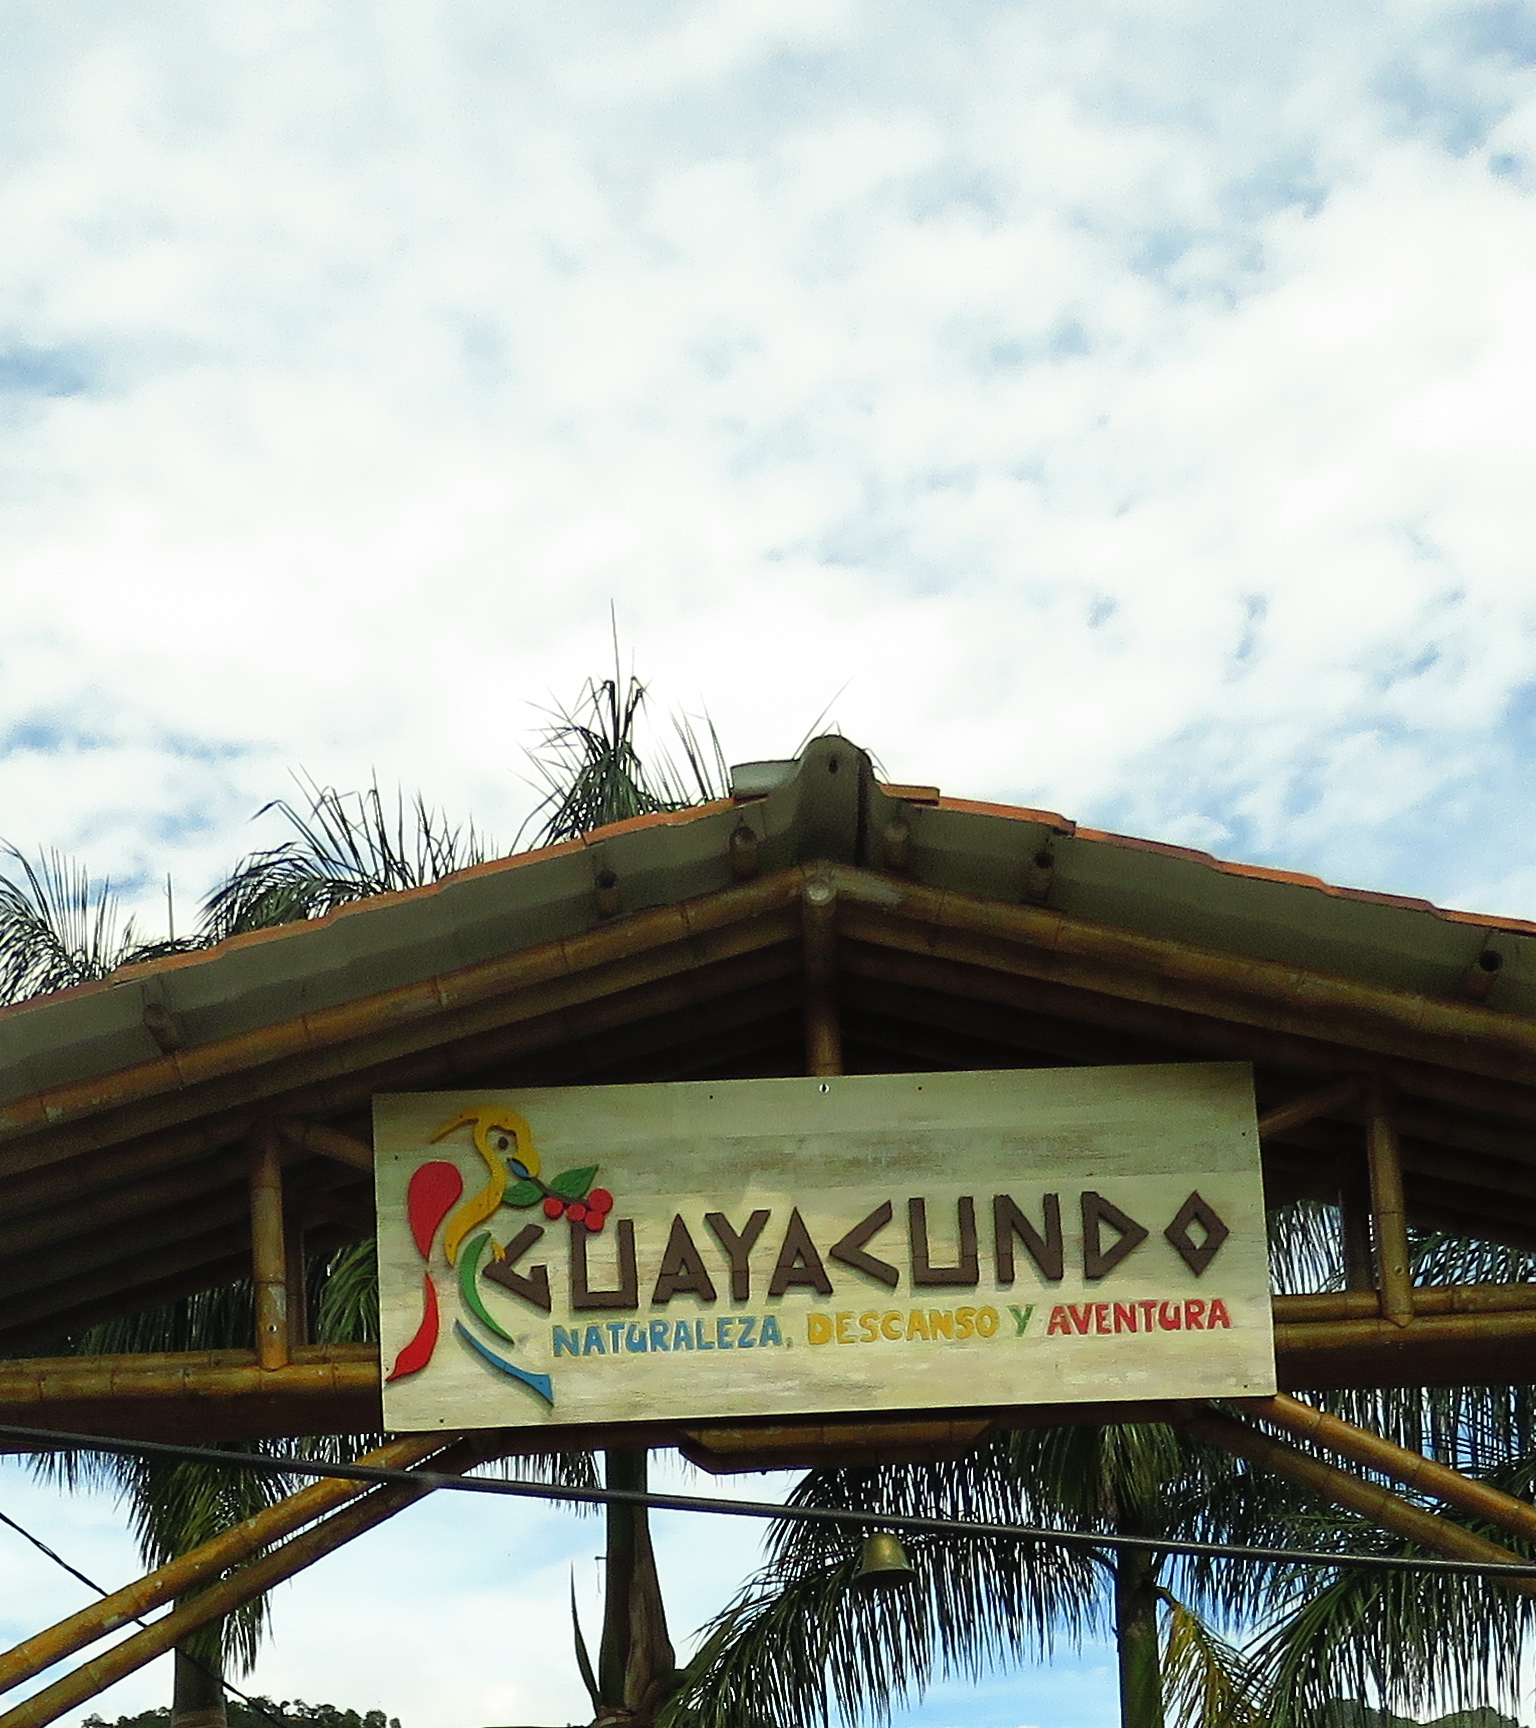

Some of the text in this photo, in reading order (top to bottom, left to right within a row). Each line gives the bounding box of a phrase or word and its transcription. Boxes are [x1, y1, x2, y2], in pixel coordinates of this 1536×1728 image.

[482, 1190, 1231, 1313] GUAYACUNDO
[806, 1305, 1000, 1346] DESCANSO
[1006, 1303, 1037, 1338] Y
[1046, 1298, 1233, 1337] AVENTURA
